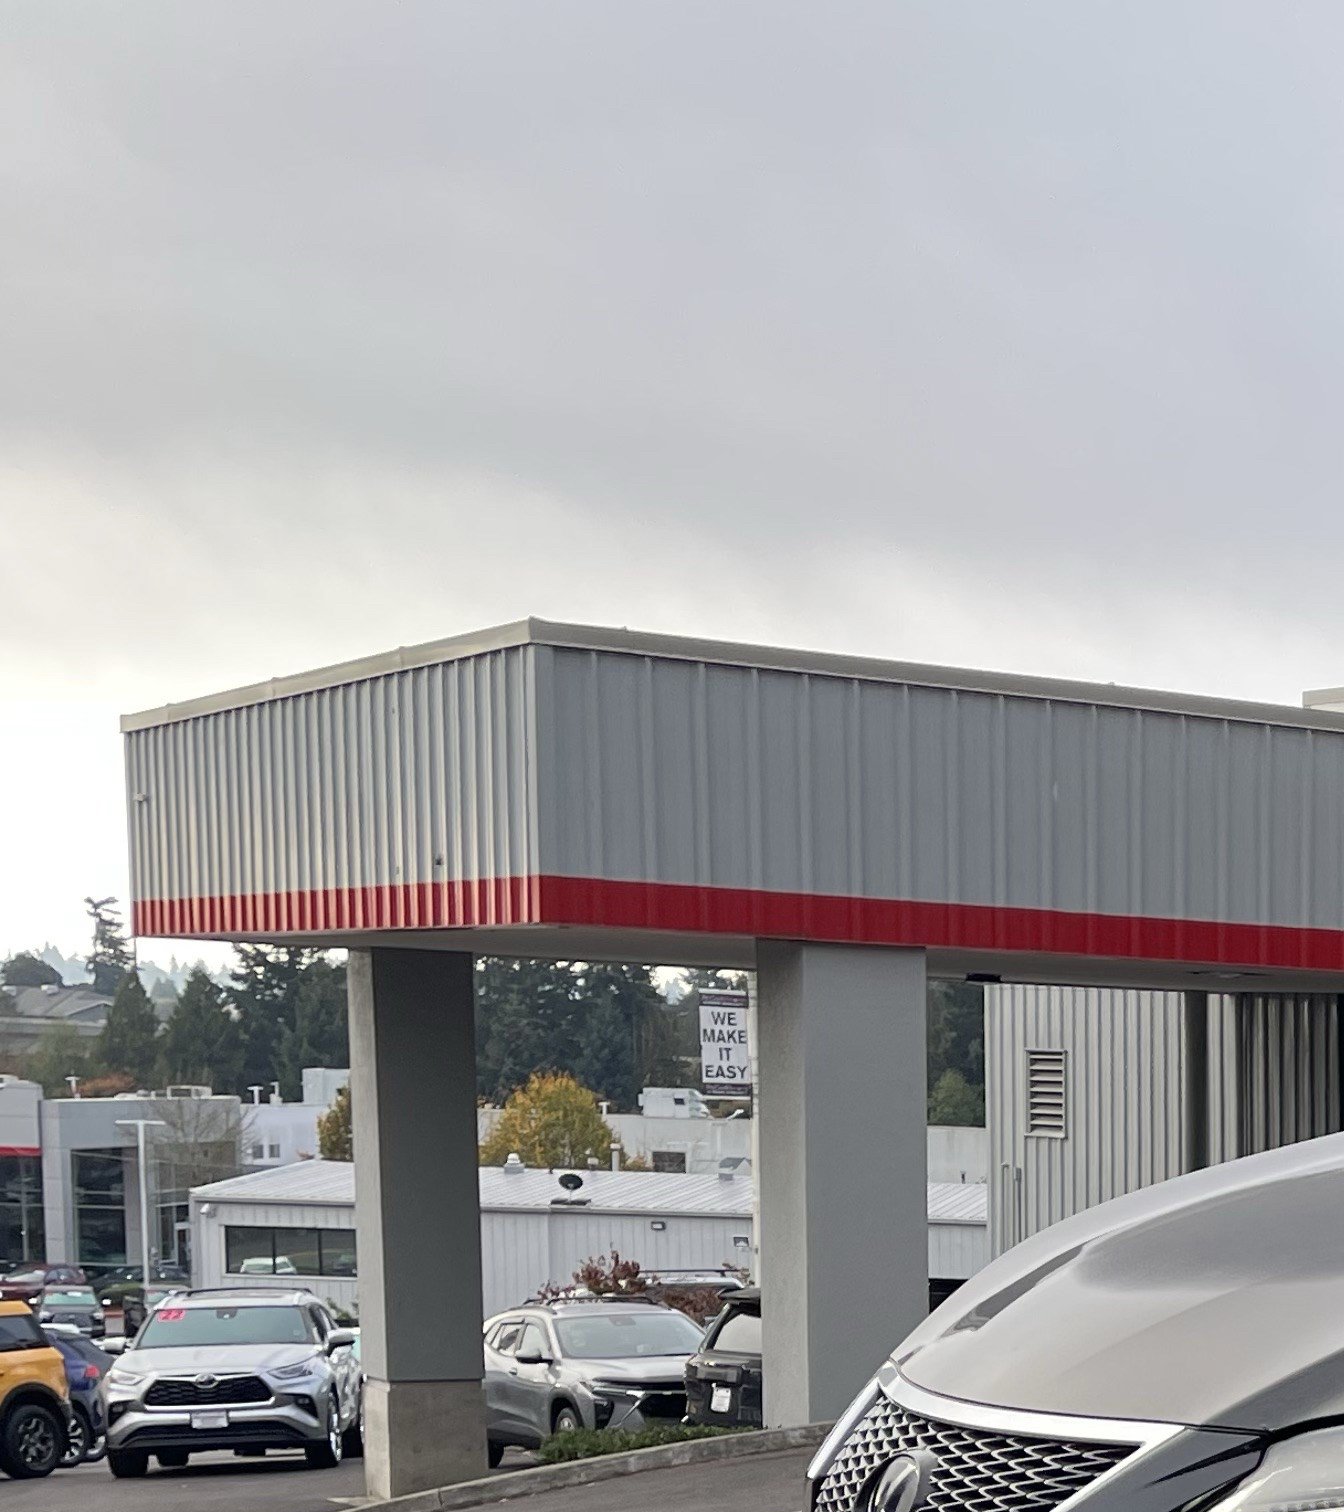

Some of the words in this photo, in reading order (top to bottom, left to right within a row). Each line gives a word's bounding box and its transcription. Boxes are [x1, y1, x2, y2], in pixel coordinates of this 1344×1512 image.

[711, 1011, 737, 1026] WE
[703, 1028, 747, 1044] MAKE
[719, 1047, 732, 1061] IT
[705, 1065, 747, 1079] EASY
